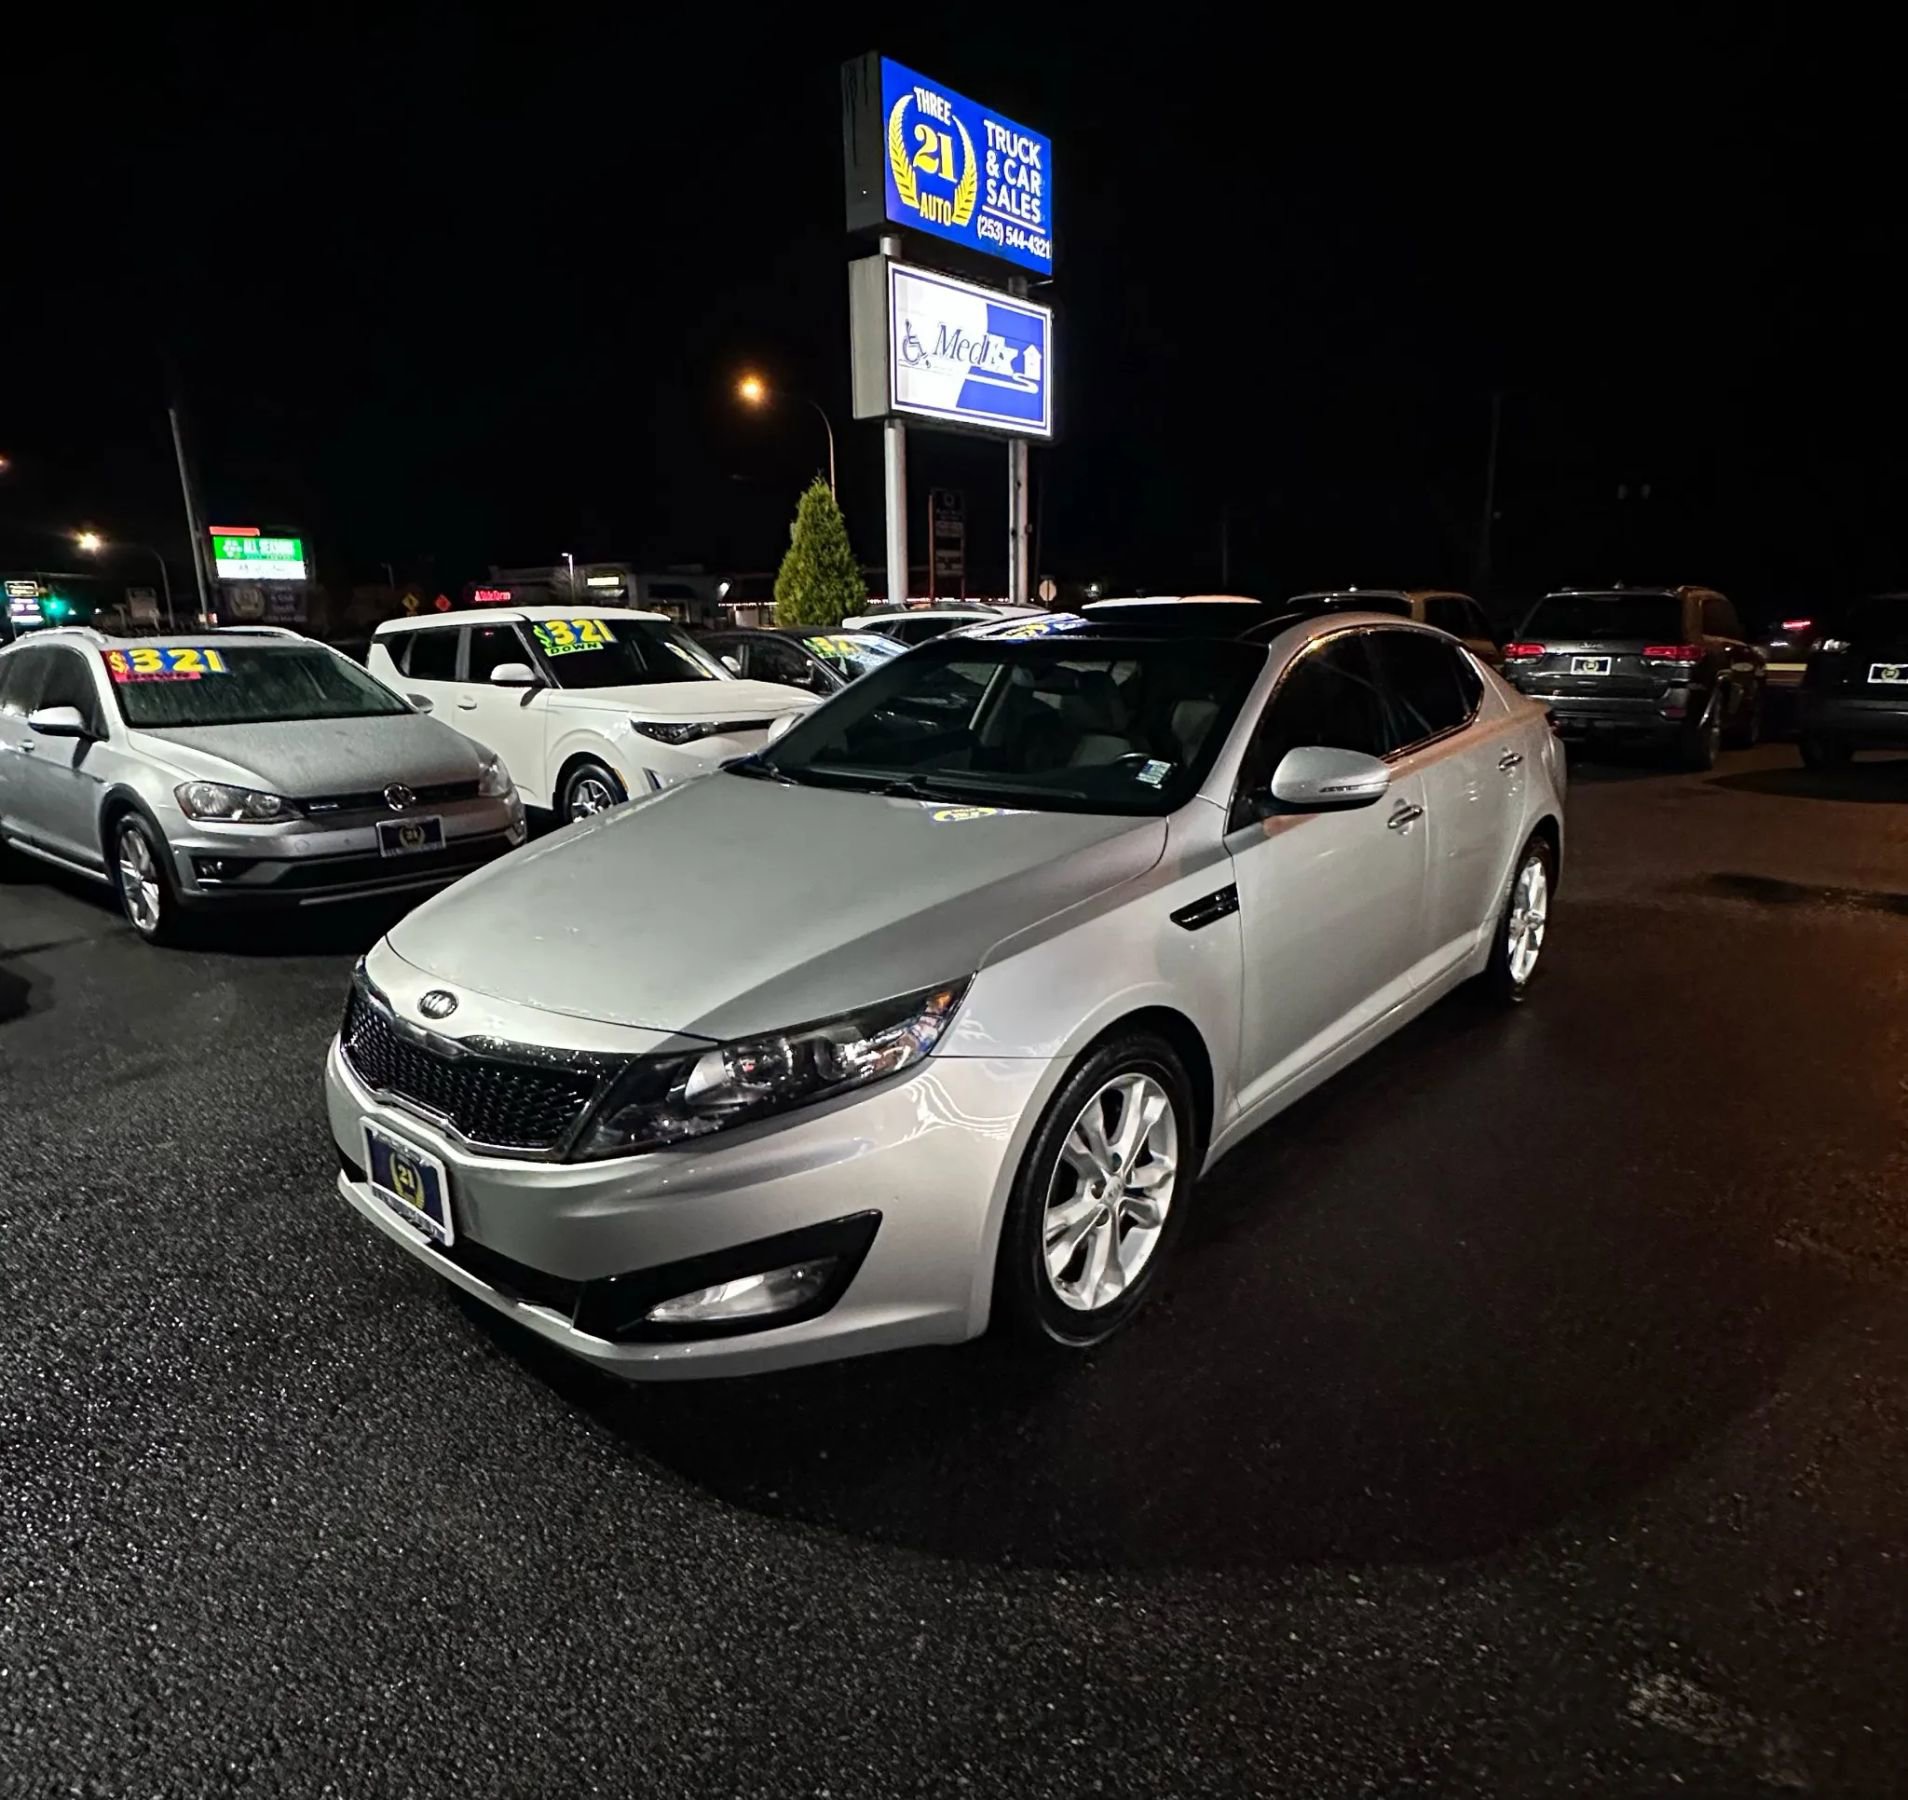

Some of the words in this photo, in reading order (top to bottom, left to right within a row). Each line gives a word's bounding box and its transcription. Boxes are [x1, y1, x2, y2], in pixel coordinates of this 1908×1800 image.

[914, 86, 951, 126] THREE
[913, 123, 958, 183] 21
[983, 119, 1042, 170] TRUCK
[986, 150, 1000, 179] &
[1003, 158, 1041, 197] CAR
[920, 192, 951, 226] AUTO
[986, 178, 1041, 224] SALES
[977, 214, 1004, 246] (253)
[1005, 225, 1050, 259] 544-4321
[109, 648, 225, 674] $321
[550, 642, 598, 654] DOWN
[398, 1163, 416, 1189] 21
